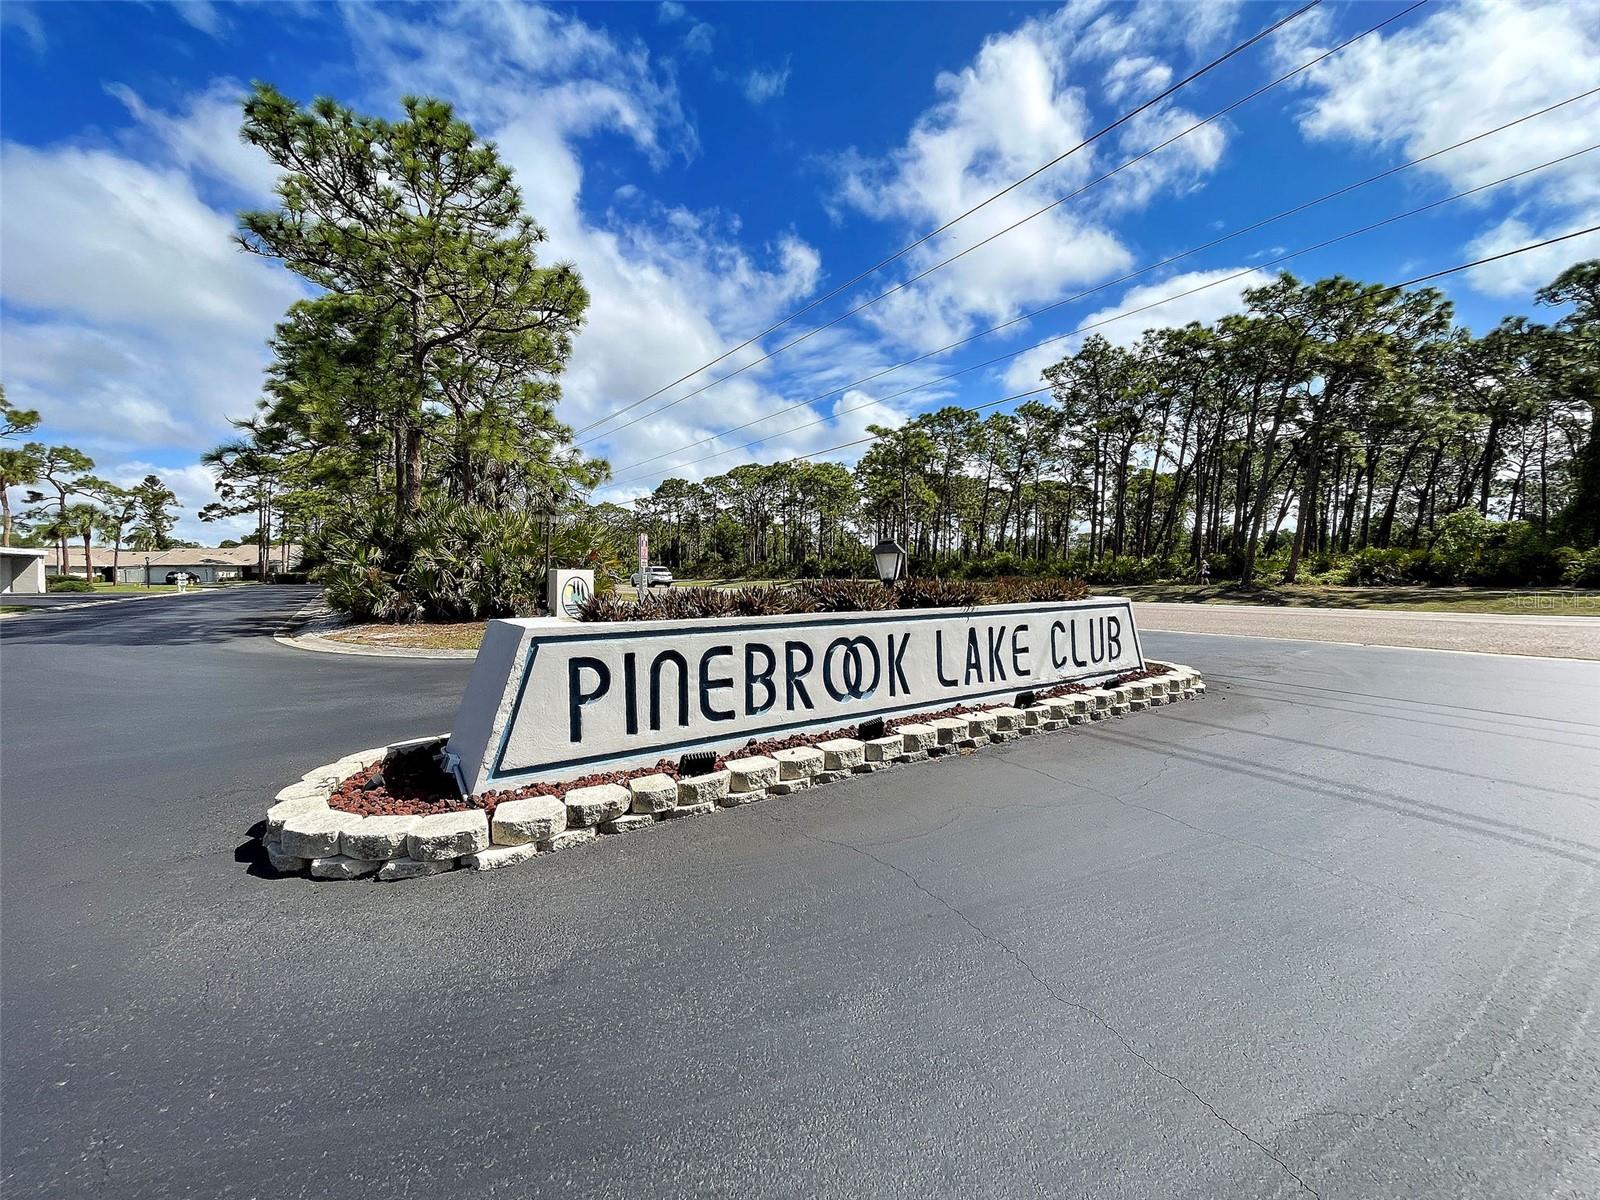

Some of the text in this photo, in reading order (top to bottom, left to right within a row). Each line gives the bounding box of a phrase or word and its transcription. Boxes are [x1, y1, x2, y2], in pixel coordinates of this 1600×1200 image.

[568, 616, 1122, 743] PINEBROOK LAKE CLUB
